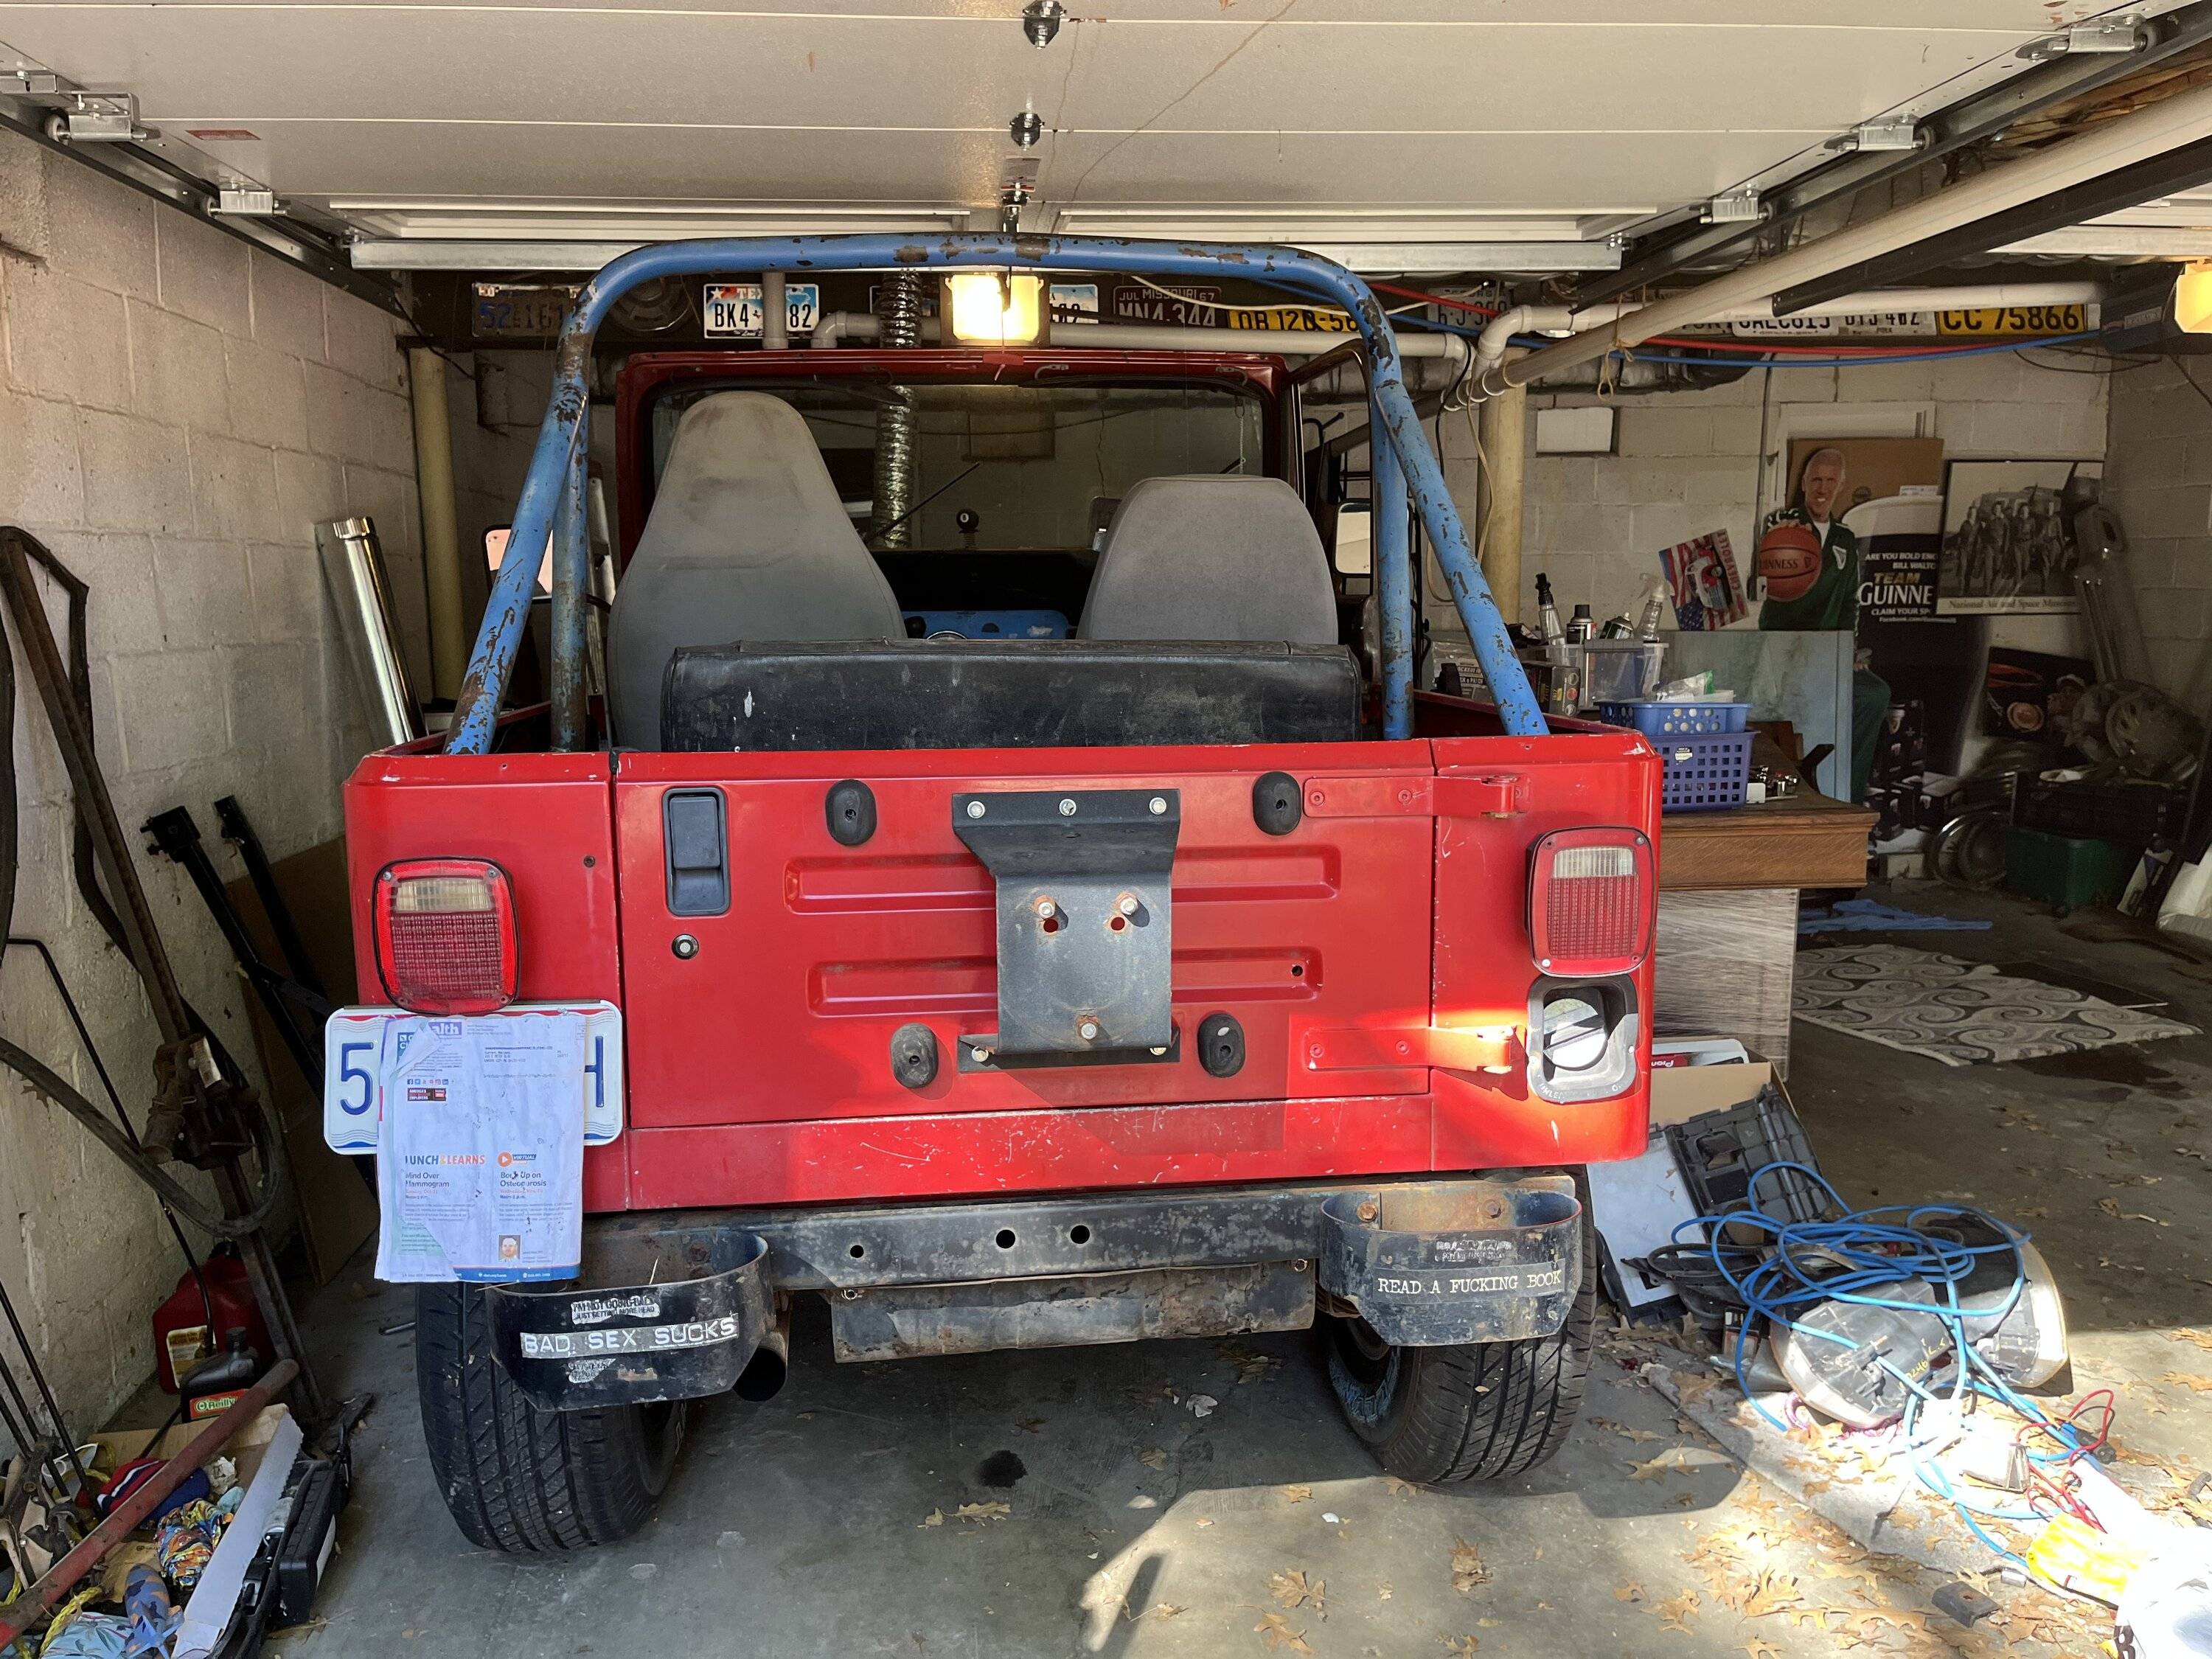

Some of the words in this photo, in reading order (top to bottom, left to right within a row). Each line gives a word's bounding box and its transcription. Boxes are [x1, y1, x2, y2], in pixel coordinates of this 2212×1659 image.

[1119, 292, 1139, 301] JUL
[1199, 293, 1215, 302] 67
[714, 303, 748, 328] BK4
[1874, 572, 1921, 584] TEAM
[1871, 608, 1896, 616] CLAIM
[340, 1042, 375, 1116] 5
[1377, 1278, 1422, 1294] READ
[1430, 1280, 1441, 1294] A
[1450, 1276, 1519, 1293] FUCKING
[1526, 1270, 1562, 1288] BOOK
[524, 1334, 570, 1352] BAD
[588, 1329, 637, 1349] SEX
[654, 1317, 736, 1345] SUCKS
